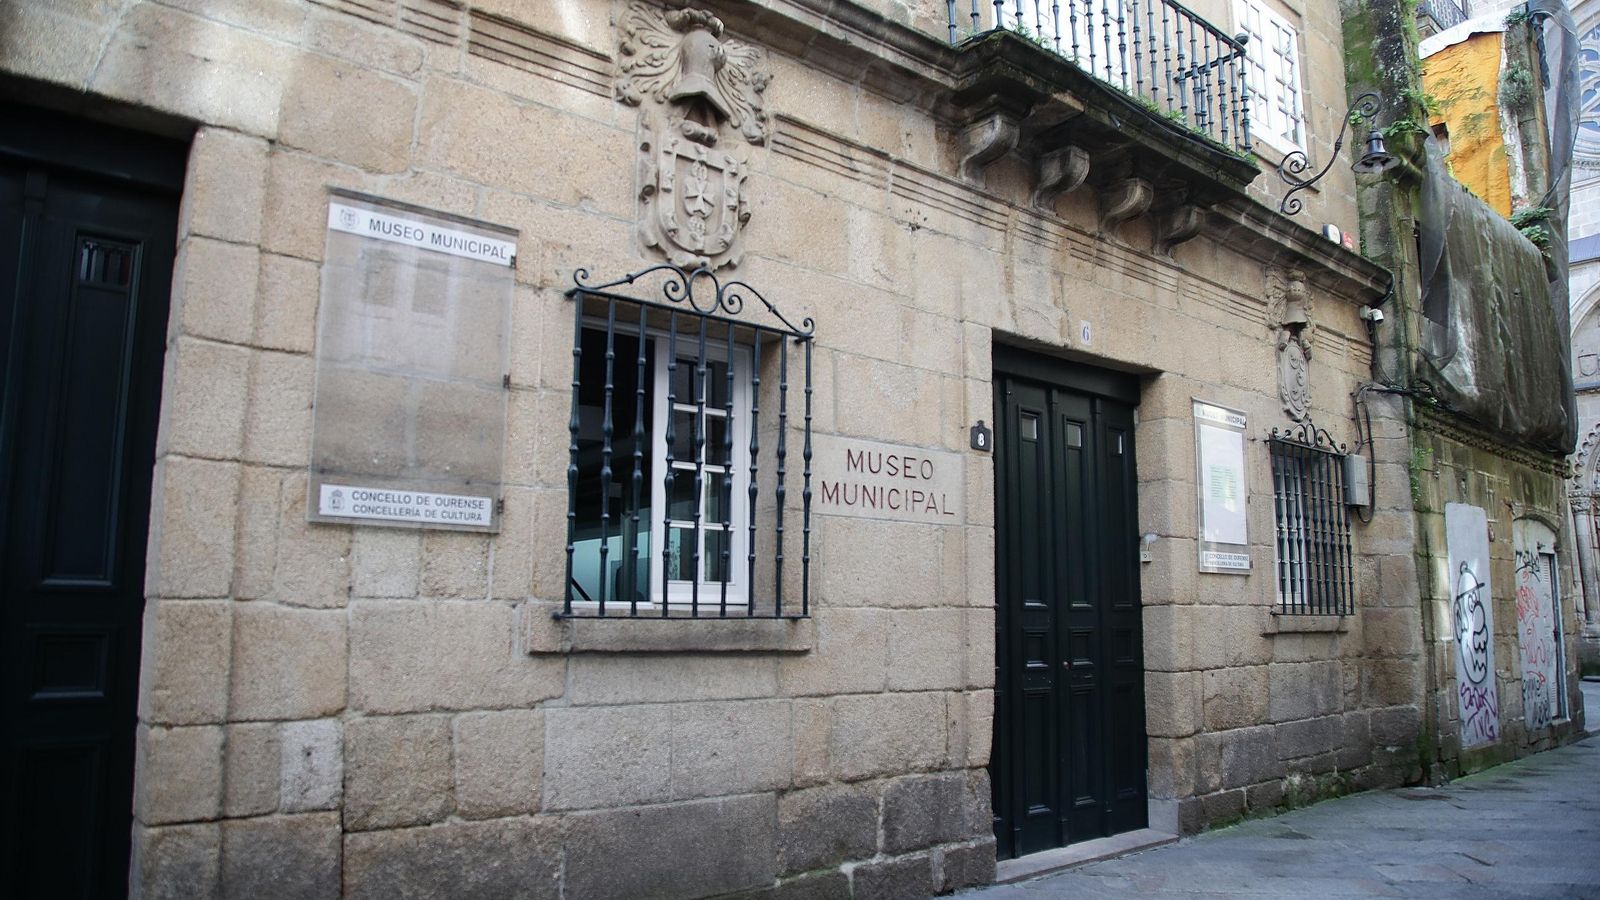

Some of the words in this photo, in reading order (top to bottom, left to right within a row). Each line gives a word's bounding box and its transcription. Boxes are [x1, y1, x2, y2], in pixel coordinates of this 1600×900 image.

[368, 218, 425, 242] MUSEO
[430, 232, 507, 260] MUNICIPAL
[1082, 324, 1090, 341] 6
[977, 432, 985, 447] 8
[847, 448, 934, 480] MUSEO
[351, 490, 412, 505] CONCELLO
[416, 496, 430, 506] DE
[434, 497, 485, 510] OURENSE
[821, 480, 955, 516] MUNICIPAL
[424, 509, 437, 518] DE
[441, 510, 483, 521] CULTURA
